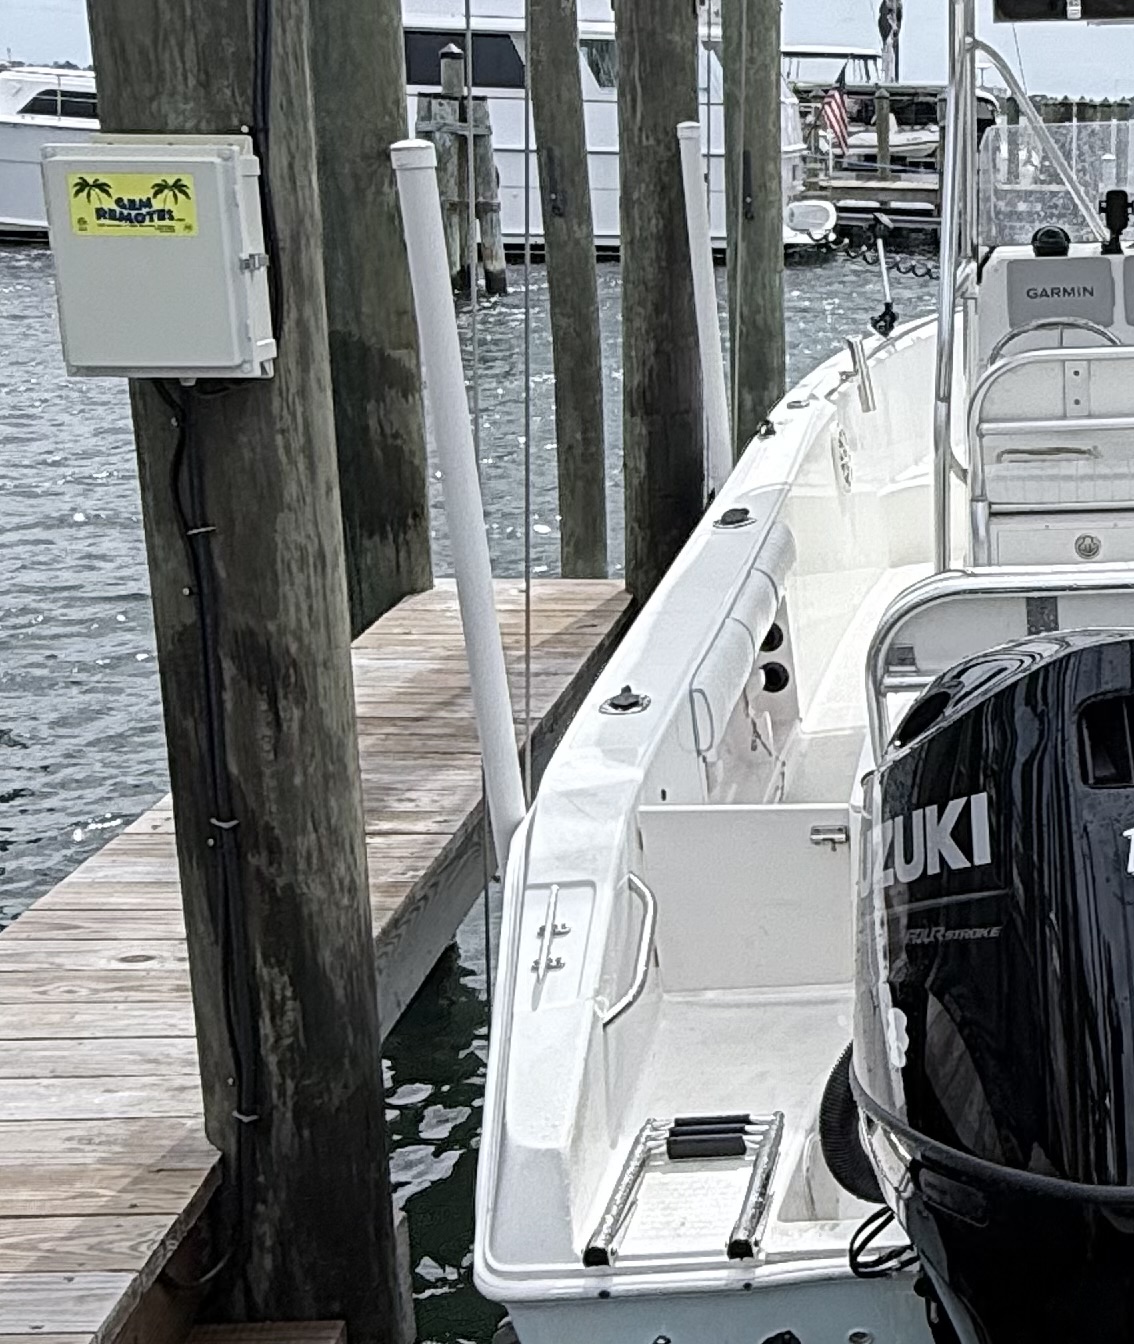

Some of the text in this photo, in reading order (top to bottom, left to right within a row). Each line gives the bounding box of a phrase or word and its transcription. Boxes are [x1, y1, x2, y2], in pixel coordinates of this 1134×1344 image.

[114, 196, 153, 211] GEM
[95, 207, 175, 224] REMOTES
[1026, 286, 1095, 299] GARMIN
